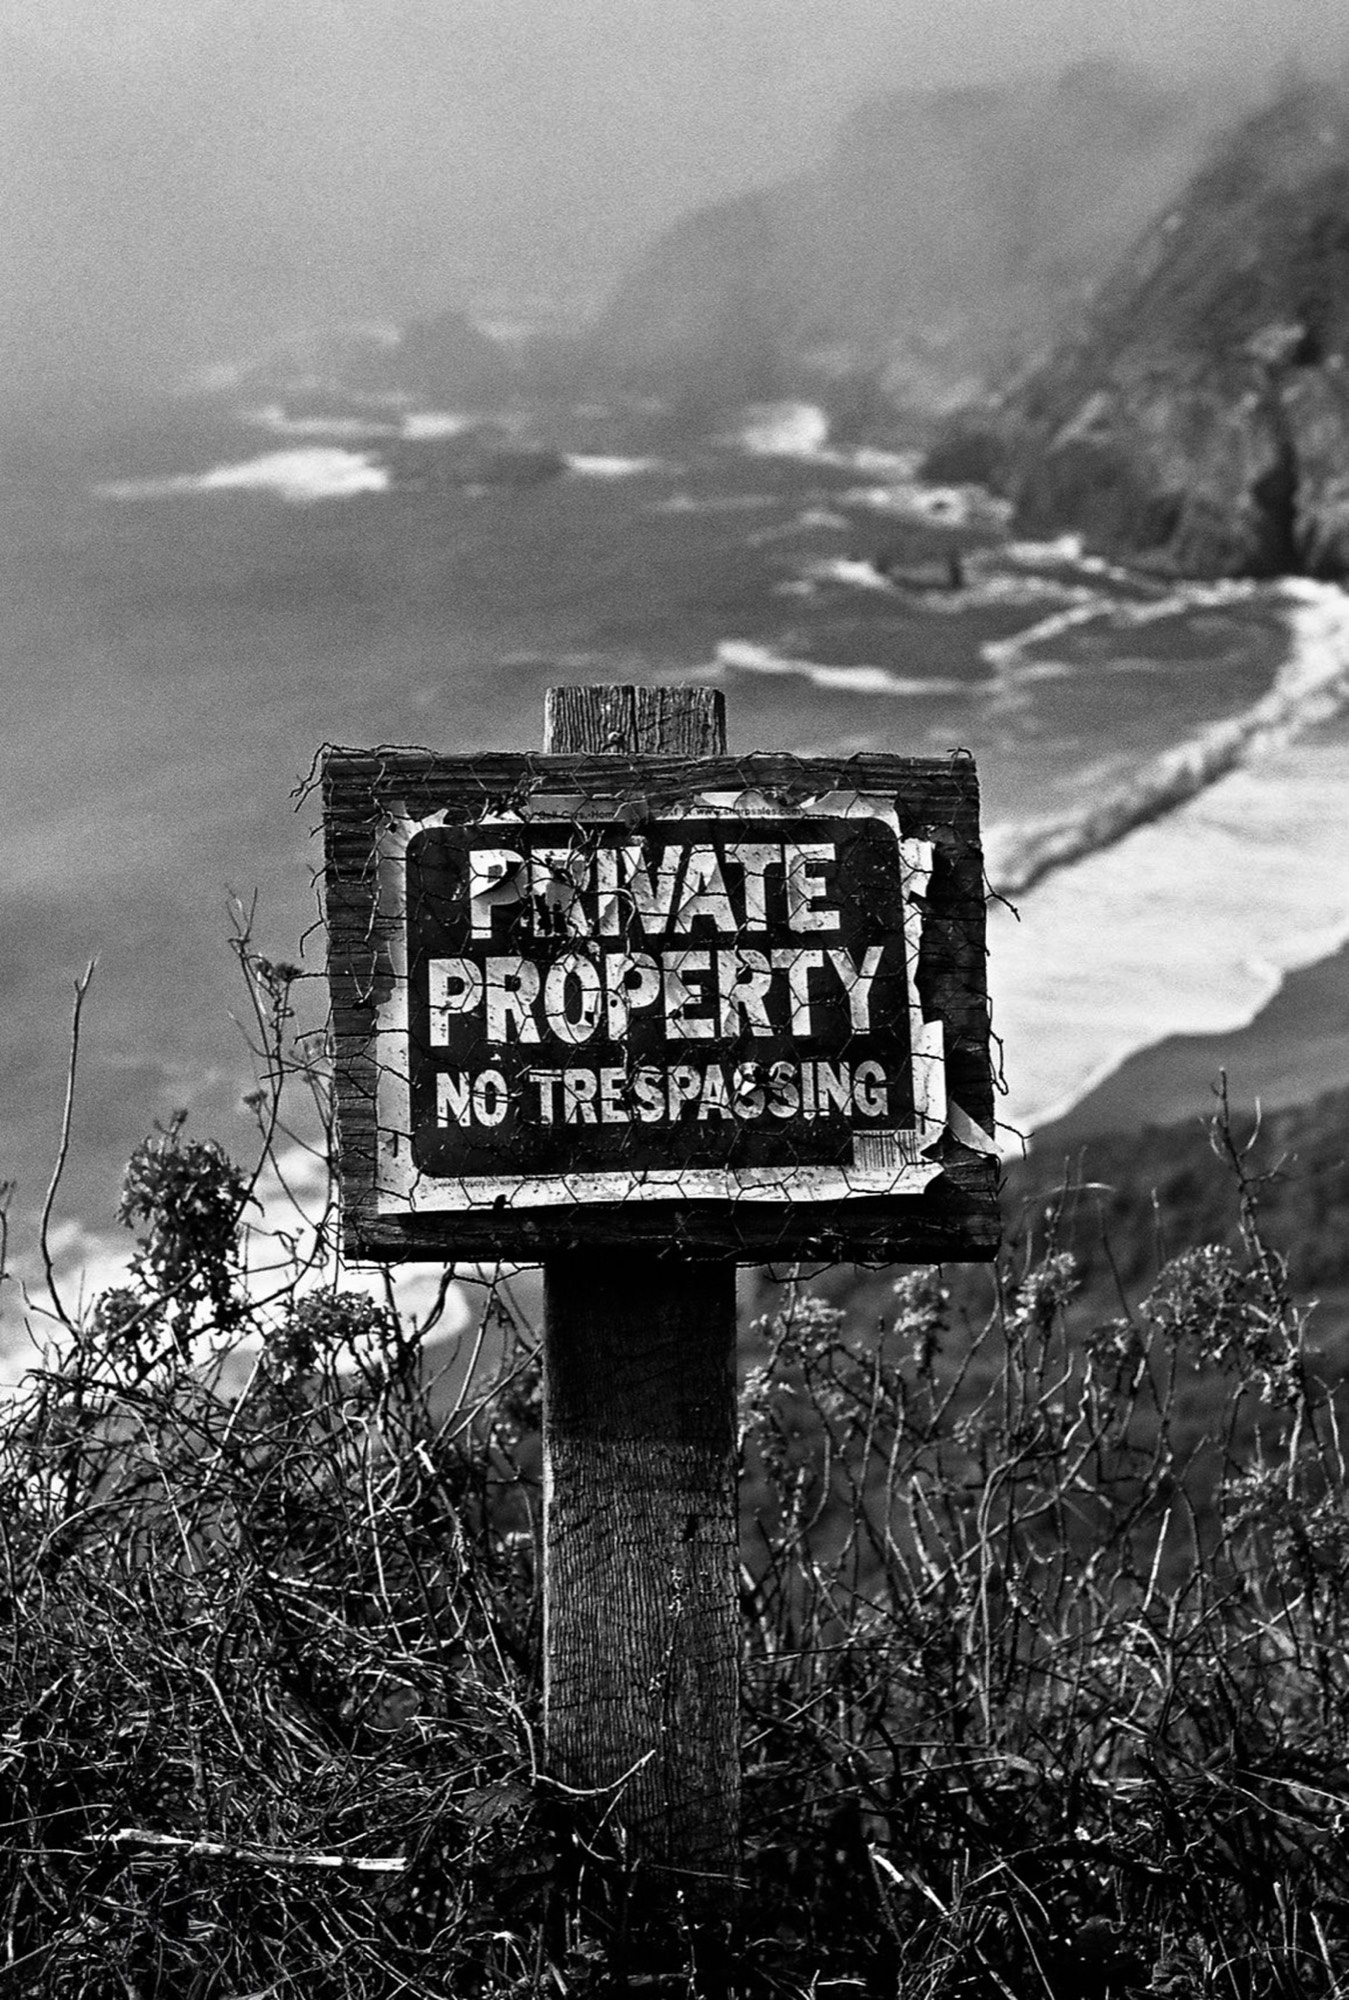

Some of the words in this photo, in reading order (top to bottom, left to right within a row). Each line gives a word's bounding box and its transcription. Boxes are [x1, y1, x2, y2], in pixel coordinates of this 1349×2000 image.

[469, 843, 841, 939] PRIVATE
[427, 946, 885, 1047] PROPERTY
[436, 1069, 509, 1129] NO
[529, 1060, 889, 1125] TRESPASSING
